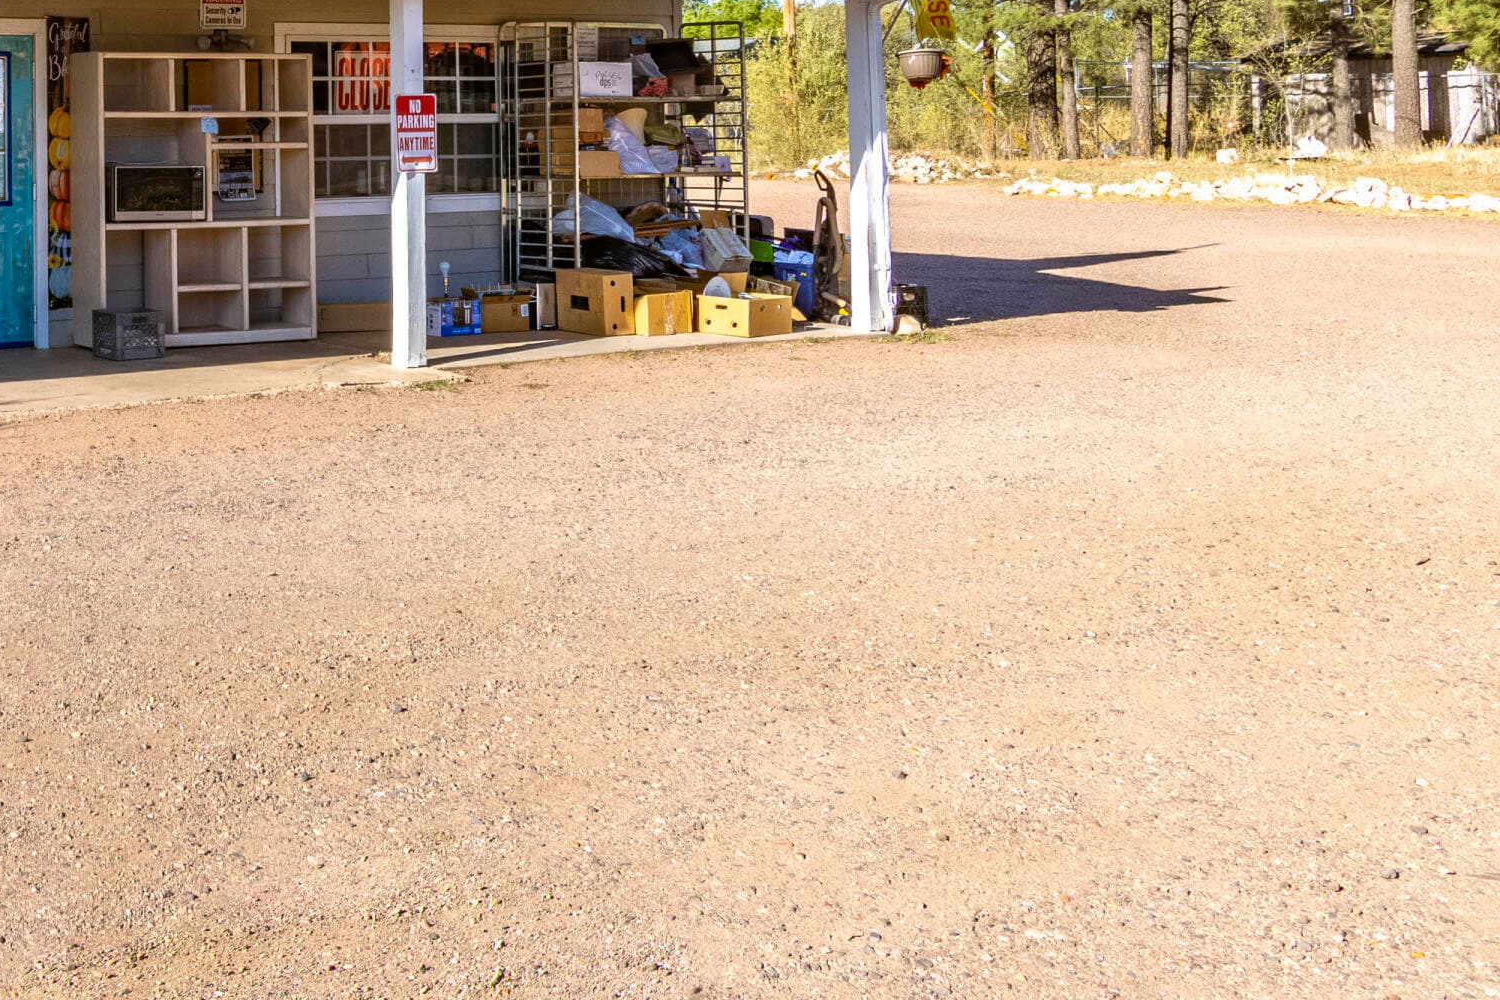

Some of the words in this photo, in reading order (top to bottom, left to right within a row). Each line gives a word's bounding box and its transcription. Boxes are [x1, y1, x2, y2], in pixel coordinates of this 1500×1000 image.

[408, 99, 421, 113] NO
[397, 114, 435, 128] PARKING
[399, 136, 434, 151] ANYTIME
